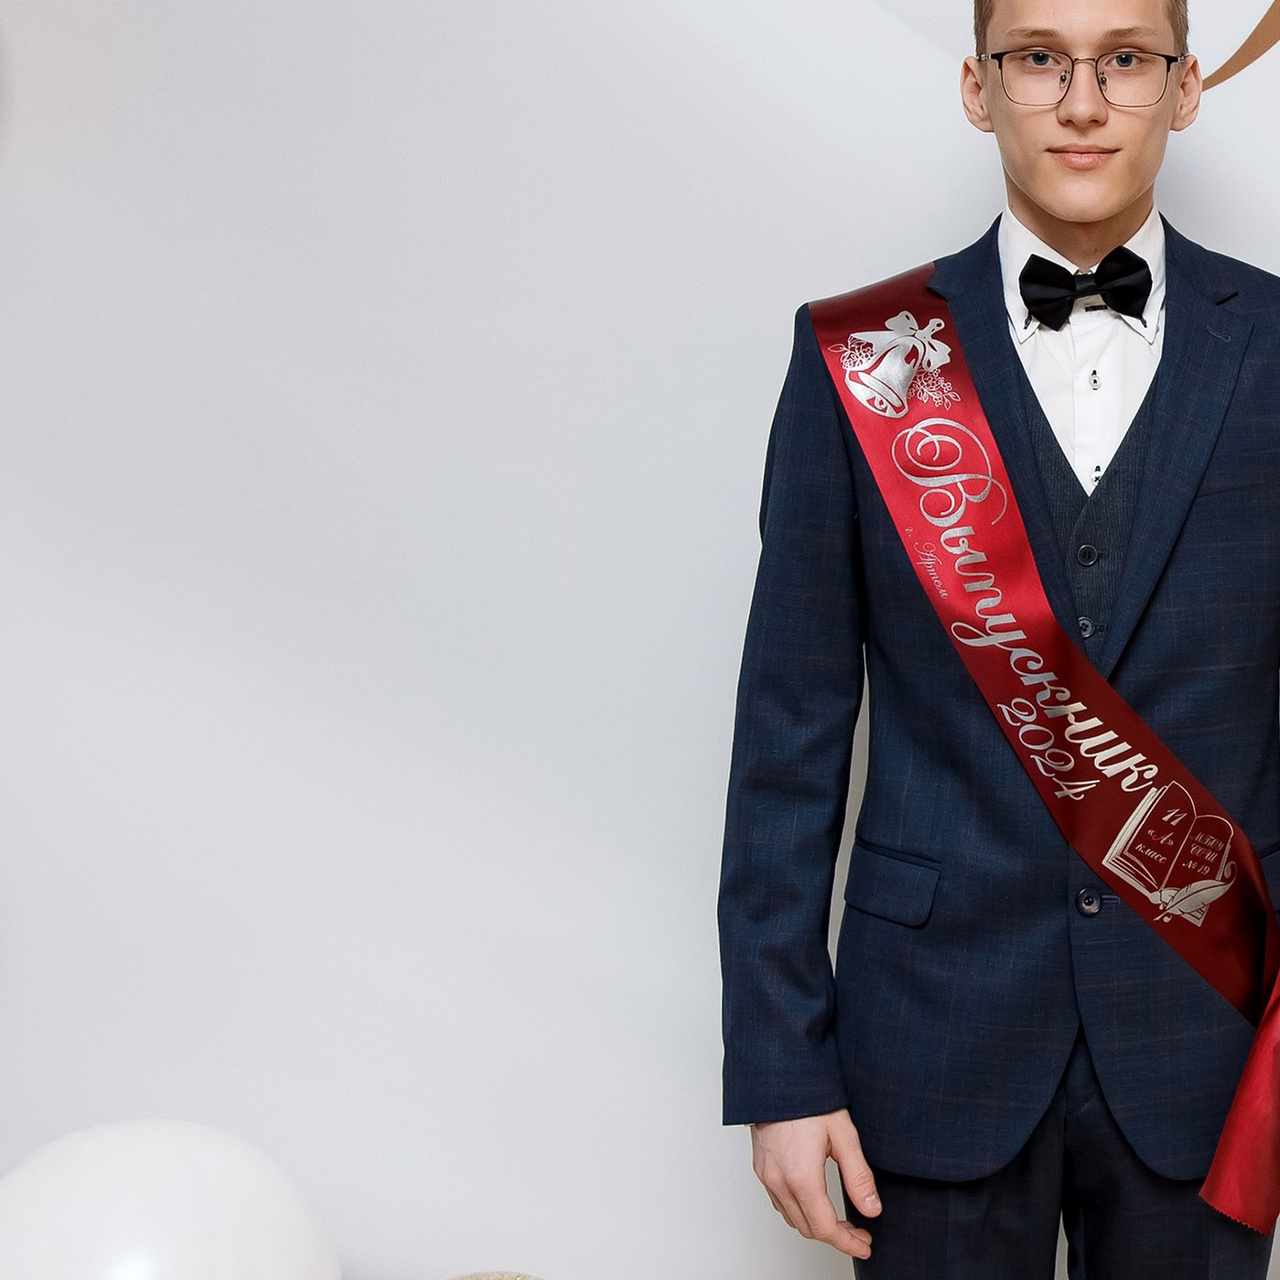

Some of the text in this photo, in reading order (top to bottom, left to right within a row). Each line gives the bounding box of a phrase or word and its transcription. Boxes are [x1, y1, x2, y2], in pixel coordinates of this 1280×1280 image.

[890, 417, 1159, 793] Выпускник
[996, 696, 1101, 801] 2024
[1162, 808, 1188, 826] 11
[1197, 865, 1211, 875] 19
